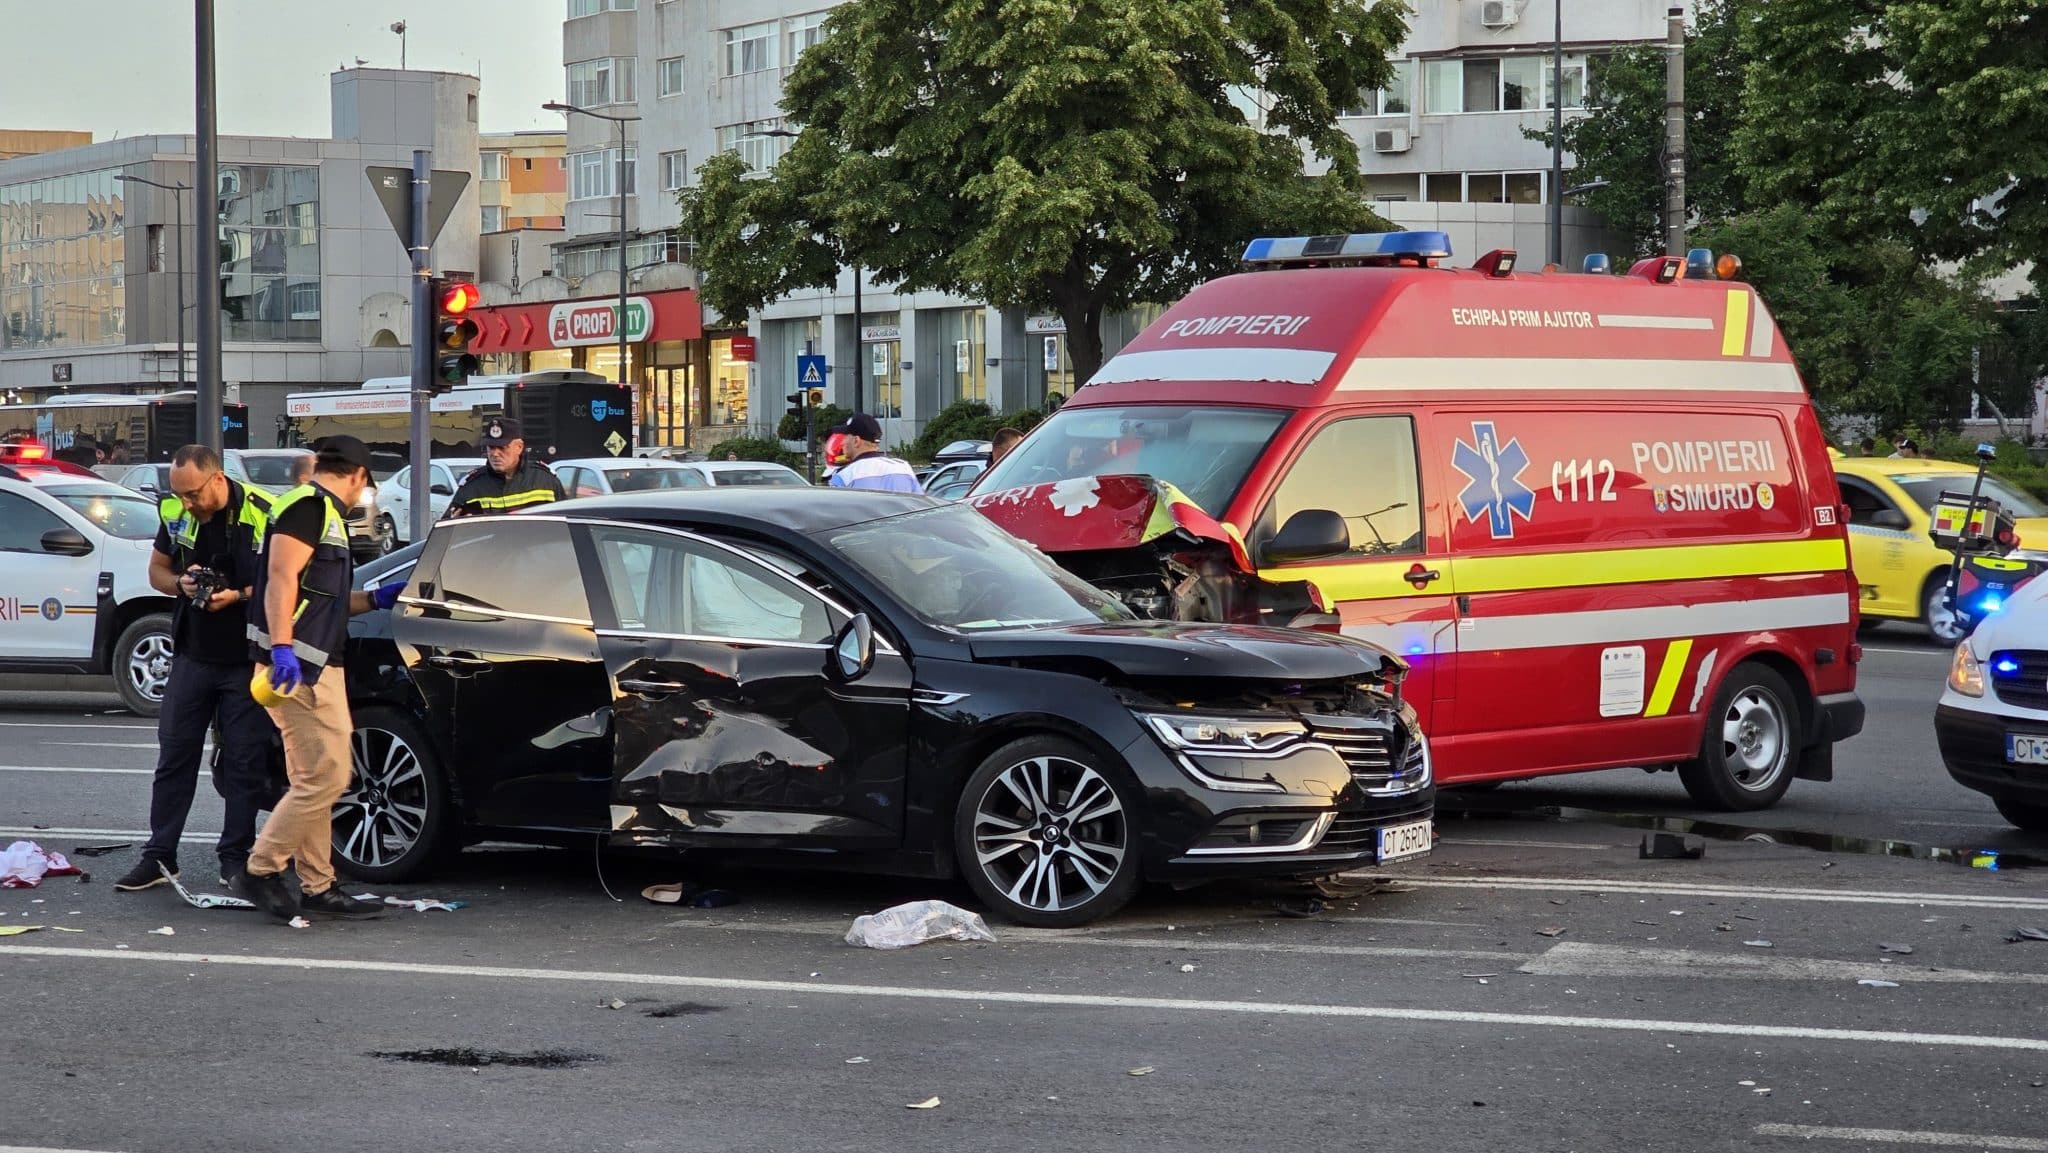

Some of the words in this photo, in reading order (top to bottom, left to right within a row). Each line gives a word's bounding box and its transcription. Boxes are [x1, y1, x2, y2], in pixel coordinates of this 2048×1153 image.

[573, 311, 611, 335] PROFI
[618, 309, 641, 330] TY
[1160, 315, 1311, 339] POMPIERII
[1452, 308, 1507, 326] ECHIPAJ
[1509, 309, 1542, 327] PRIM
[1544, 310, 1594, 328] AJUTOR
[290, 403, 311, 413] LEMS
[608, 406, 625, 416] bus
[229, 420, 243, 428] bus
[55, 429, 74, 451] bus
[1631, 440, 1776, 474] POMPIERII
[1564, 458, 1617, 502] 112
[1670, 482, 1754, 512] SMURD
[1819, 509, 1831, 523] B2
[2016, 739, 2035, 759] CT
[1384, 831, 1397, 854] CT
